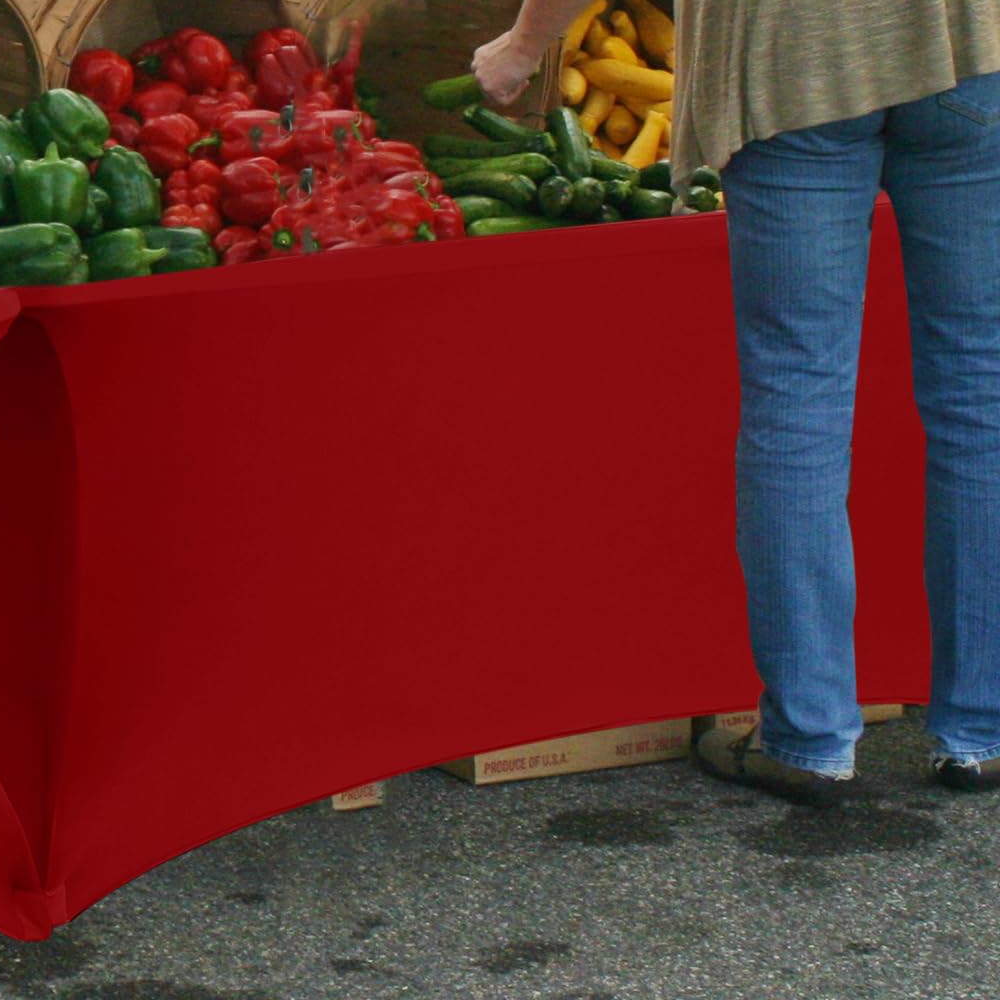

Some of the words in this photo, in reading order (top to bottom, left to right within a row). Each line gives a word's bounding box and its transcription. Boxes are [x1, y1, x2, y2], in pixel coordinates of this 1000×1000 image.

[483, 757, 526, 775] PRODUCE
[528, 755, 541, 769] OF
[615, 742, 632, 757] NET
